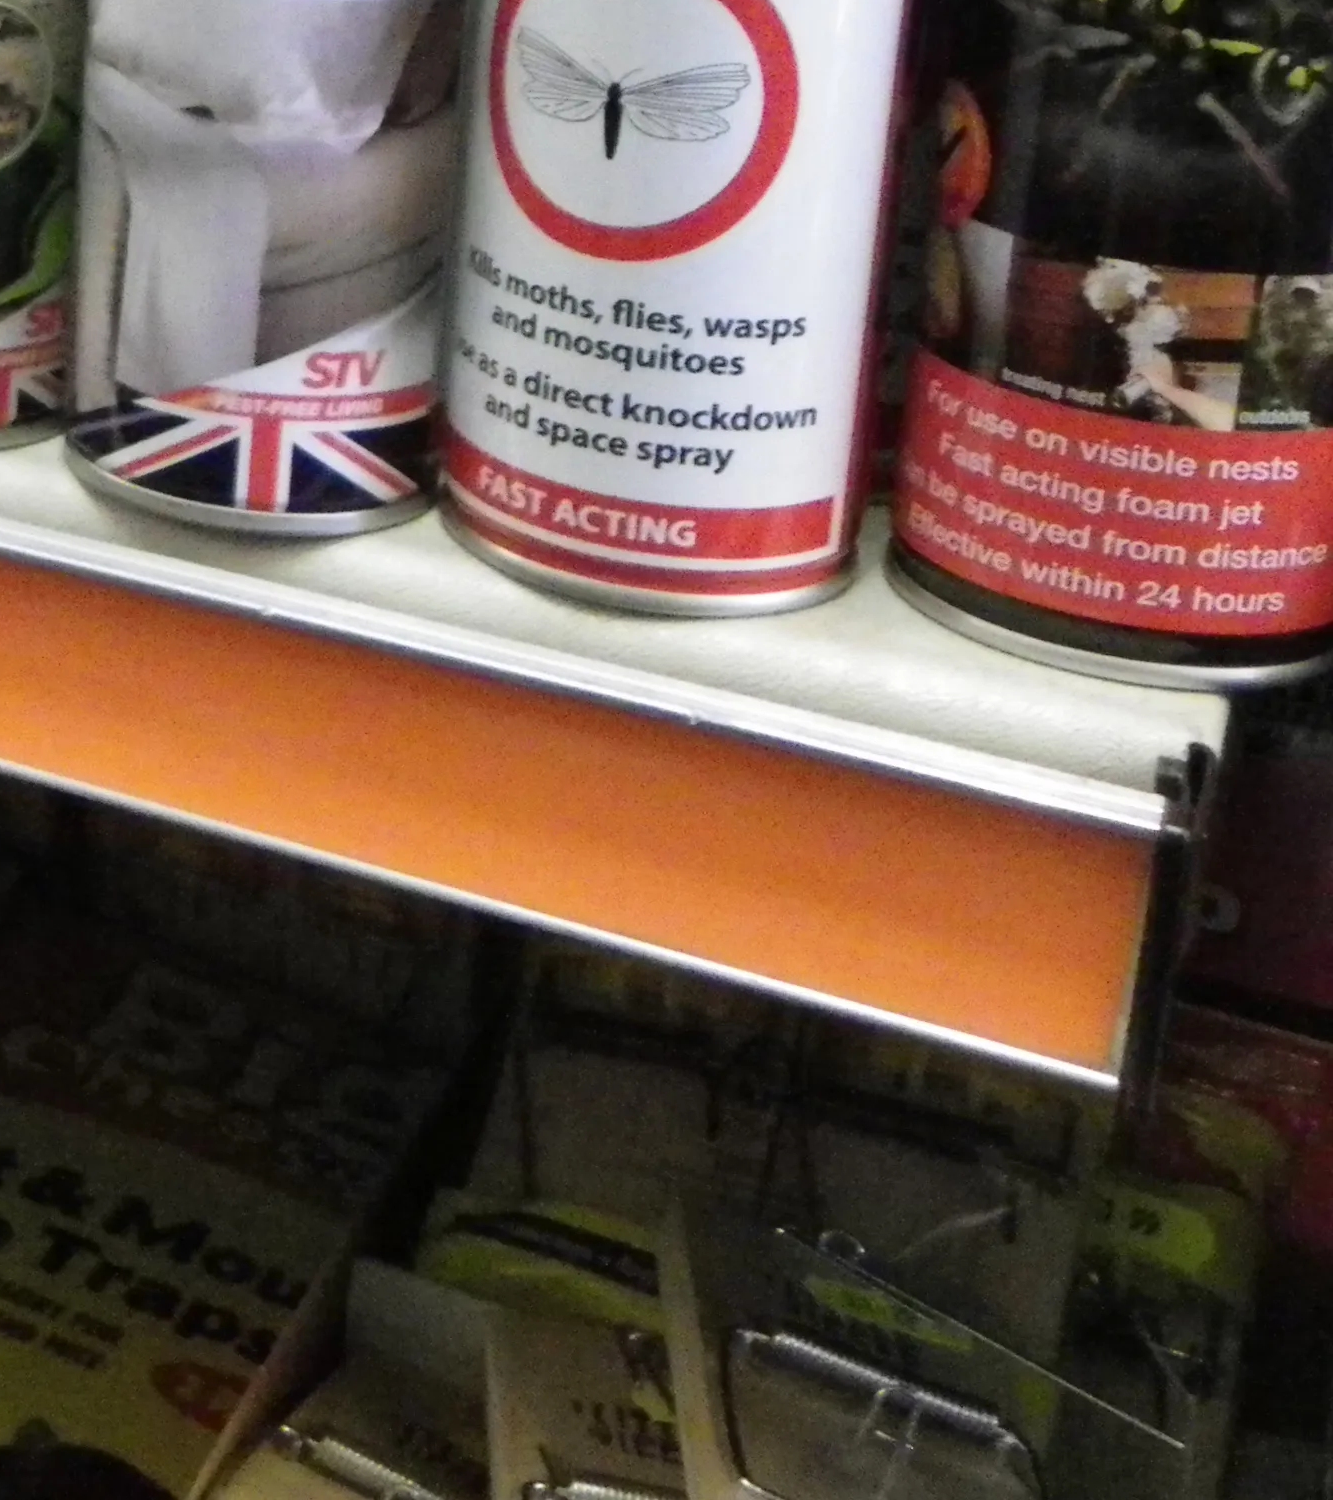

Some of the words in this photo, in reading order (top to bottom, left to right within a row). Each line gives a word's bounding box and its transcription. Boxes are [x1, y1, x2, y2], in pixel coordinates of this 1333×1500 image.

[490, 302, 537, 341] and
[543, 322, 747, 378] mosquitoes
[505, 266, 604, 325] moths,
[611, 298, 695, 340] flies,
[703, 312, 809, 346] wasps
[301, 349, 386, 390] STV
[476, 351, 501, 381] as
[503, 367, 518, 388] a
[522, 371, 615, 419] direct
[620, 393, 819, 433] knockdown
[483, 393, 531, 431] and
[535, 411, 630, 458] space
[636, 438, 735, 475] spray
[966, 407, 1020, 441] use
[1025, 427, 1070, 457] on
[1079, 439, 1199, 480] visible
[1207, 454, 1300, 483] nests
[475, 464, 549, 517] FAST
[552, 498, 699, 549] ACTING
[938, 432, 995, 478] Fast
[1000, 462, 1106, 515] acting
[1116, 486, 1211, 526] foam
[1216, 499, 1266, 532] jet
[928, 477, 960, 507] be
[962, 491, 1093, 551] sprayed
[1101, 528, 1188, 568] from
[1196, 539, 1330, 571] distance
[1019, 558, 1127, 602] within
[1136, 581, 1183, 609] 24
[1191, 585, 1286, 614] hours
